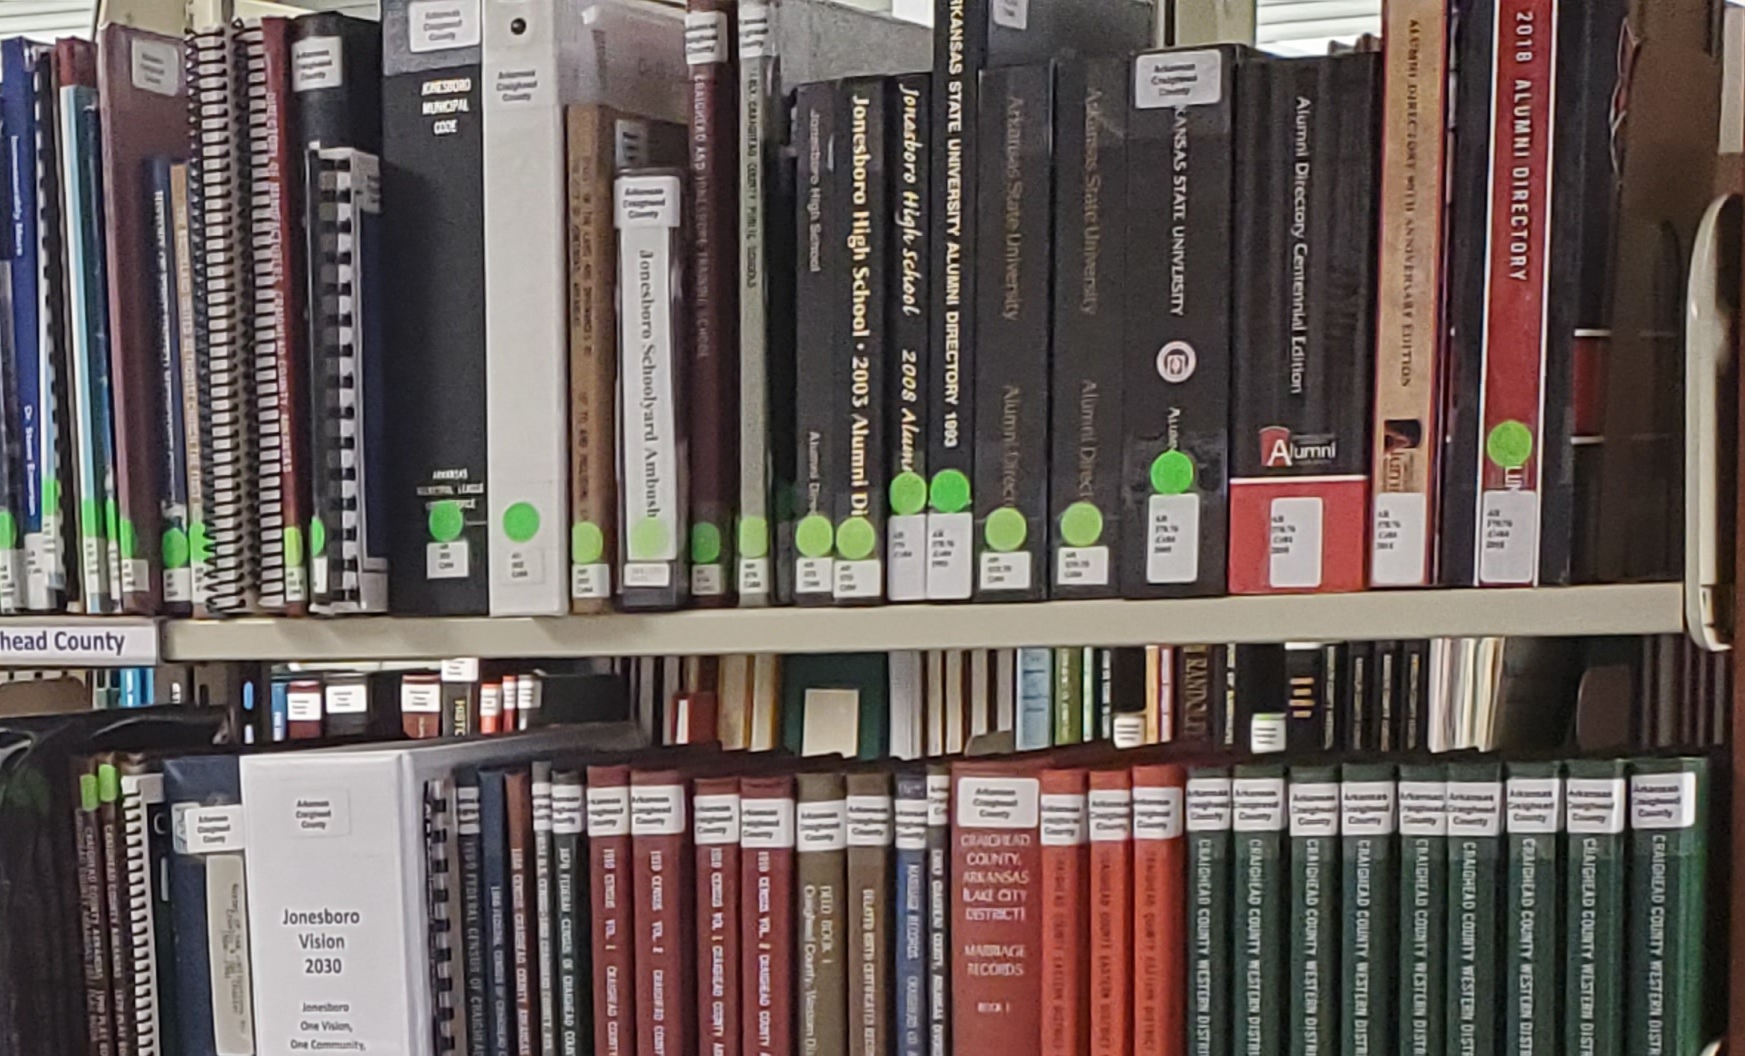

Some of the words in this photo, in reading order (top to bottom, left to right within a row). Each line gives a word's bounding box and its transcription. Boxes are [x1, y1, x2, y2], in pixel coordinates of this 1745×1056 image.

[1515, 10, 1533, 61] 2018
[898, 83, 919, 184] Jonesboro
[947, 80, 962, 132] STATE
[1294, 96, 1310, 156] Alumni
[1512, 79, 1532, 156] ALUMNI
[852, 95, 869, 204] Jonesboro
[1172, 104, 1187, 170] KANSAS
[945, 138, 961, 236] UNIVERSITY
[1291, 162, 1308, 238] Directory
[847, 211, 870, 260] High
[894, 191, 922, 244] High
[1508, 166, 1529, 280] DIRECTORY
[639, 249, 654, 339] Jonesboro
[901, 248, 920, 315] School
[945, 241, 960, 305] ALUMNI
[1079, 225, 1099, 316] University
[1291, 242, 1307, 331] Centennial
[852, 267, 870, 336] School
[851, 356, 868, 407] 2003
[901, 349, 916, 401] 2008
[944, 310, 959, 404] DIRECTORY
[1290, 335, 1306, 393] Edition
[641, 343, 657, 441] Schoolyard
[1080, 378, 1097, 442] Alumni
[851, 413, 868, 486] Alumni
[1078, 446, 1096, 500] Direct
[1266, 439, 1336, 466] Alumni
[644, 447, 660, 518] Ambush
[54, 631, 125, 656] County
[963, 871, 1029, 884] ARKANSAS
[1354, 839, 1370, 906] CRAIGHEAD
[1461, 841, 1476, 909] CRAIGHEAD
[1519, 837, 1535, 906] CRAIGHEAD
[1650, 834, 1666, 903] CRAIGHEAD
[282, 908, 360, 925] Jonesboro
[298, 932, 345, 949] Vision
[1355, 909, 1369, 957] COUNTY
[1461, 912, 1475, 960] COUNTY
[1519, 910, 1534, 959] COUNTY
[1649, 906, 1664, 956] COUNTY
[304, 958, 342, 974] 2030
[1354, 961, 1368, 1016] WESTERN
[1460, 965, 1475, 1020] WESTERN
[1518, 963, 1533, 1018] WESTERN
[1647, 959, 1663, 1016] WESTERN
[300, 1021, 319, 1031] One
[302, 1002, 349, 1012] Jonesboro
[290, 1039, 308, 1049] One
